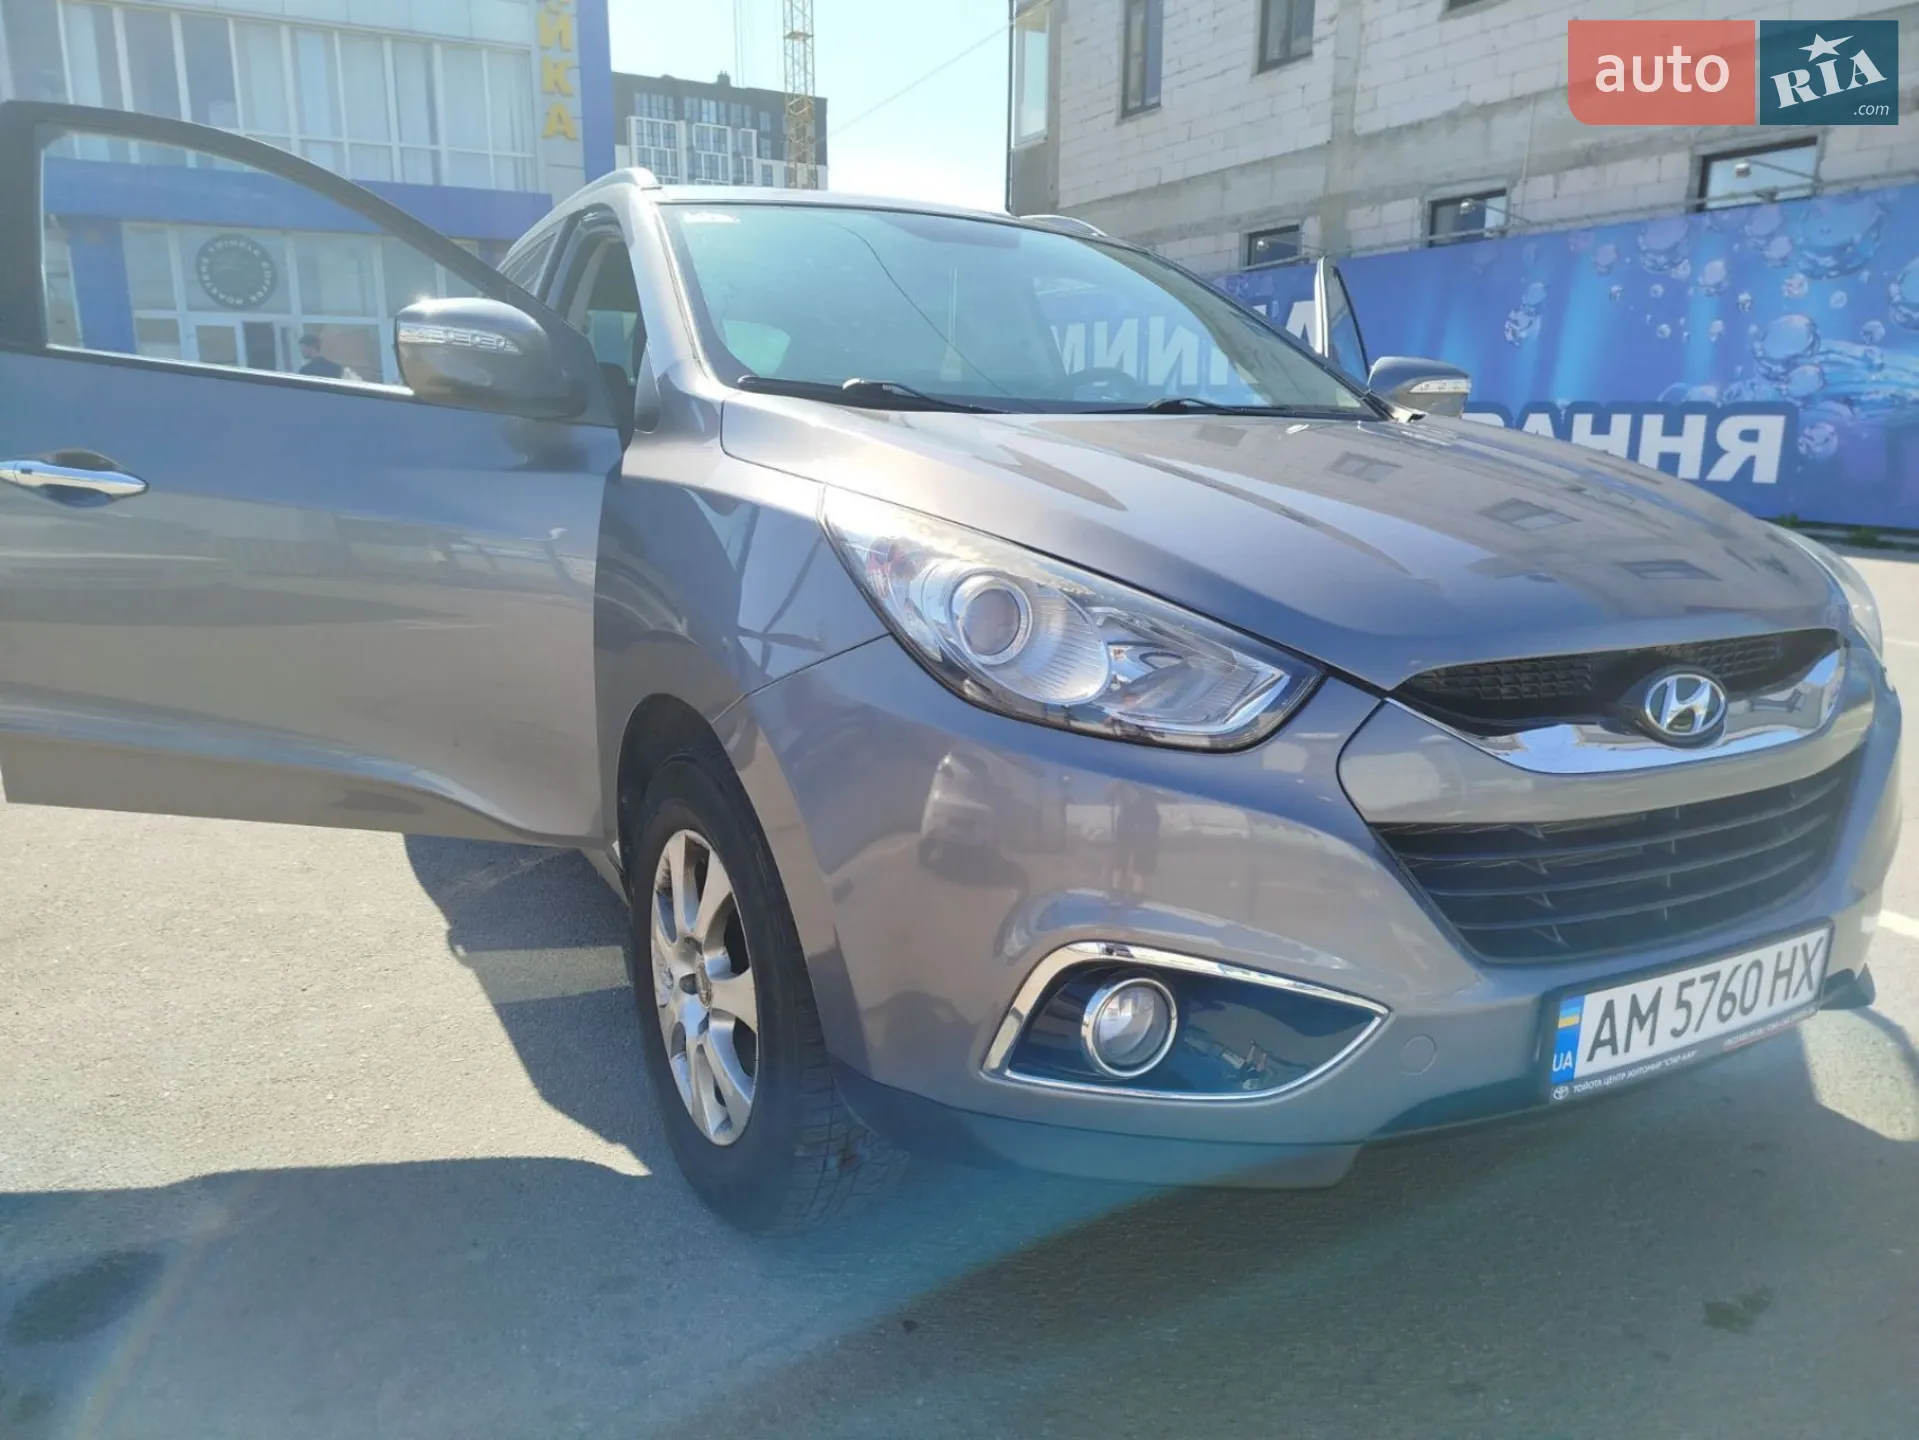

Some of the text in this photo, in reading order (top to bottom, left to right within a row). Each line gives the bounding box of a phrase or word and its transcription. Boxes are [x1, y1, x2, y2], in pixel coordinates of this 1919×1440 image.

[1462, 412, 1785, 484] ННЯ
[1586, 986, 1663, 1063] AM
[1670, 958, 1764, 1039] 5760
[1766, 935, 1824, 1008] HX
[1552, 1051, 1573, 1072] UA
